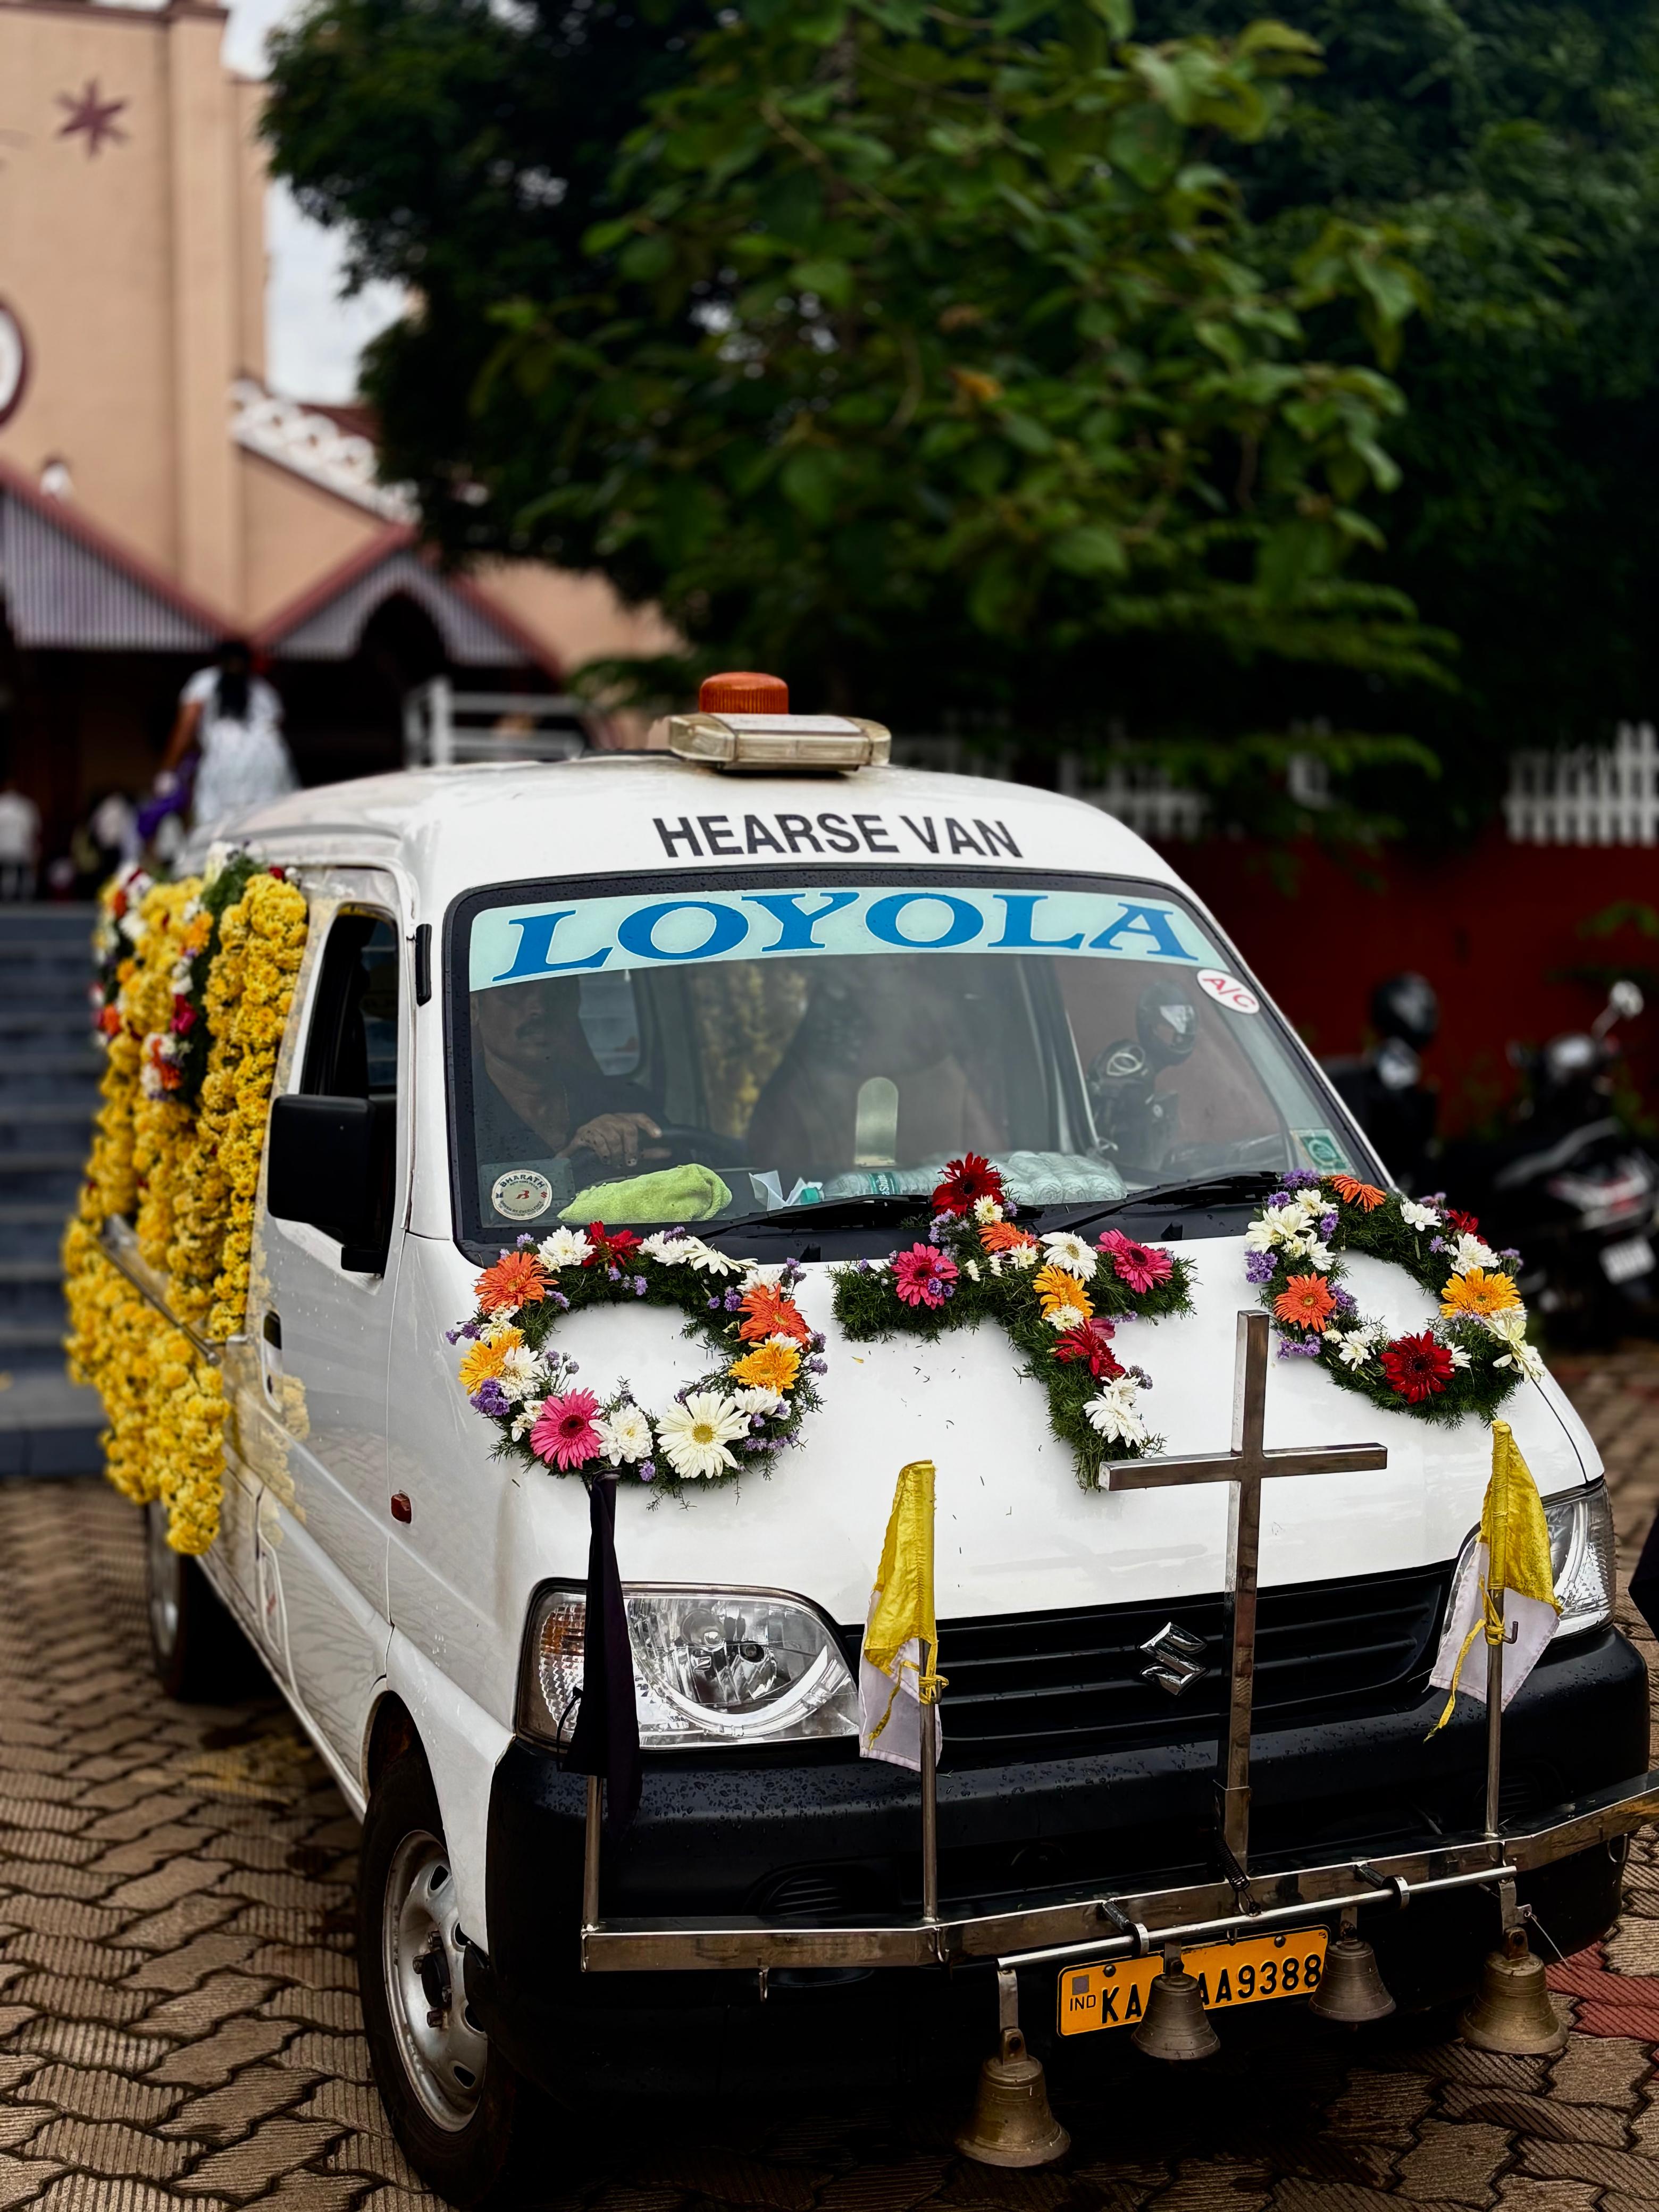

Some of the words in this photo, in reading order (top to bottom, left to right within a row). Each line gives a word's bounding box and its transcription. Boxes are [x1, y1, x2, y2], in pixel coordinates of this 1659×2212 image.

[652, 814, 900, 858] HEARSE
[900, 815, 1023, 858] VAN
[492, 892, 1199, 982] LOYOLA
[1202, 978, 1255, 1007] A/C
[500, 1175, 545, 1188] BHARATH
[877, 1175, 890, 1195] aShure
[1070, 1995, 1096, 2012] IND
[1102, 1954, 1321, 2024] KAAA9388
